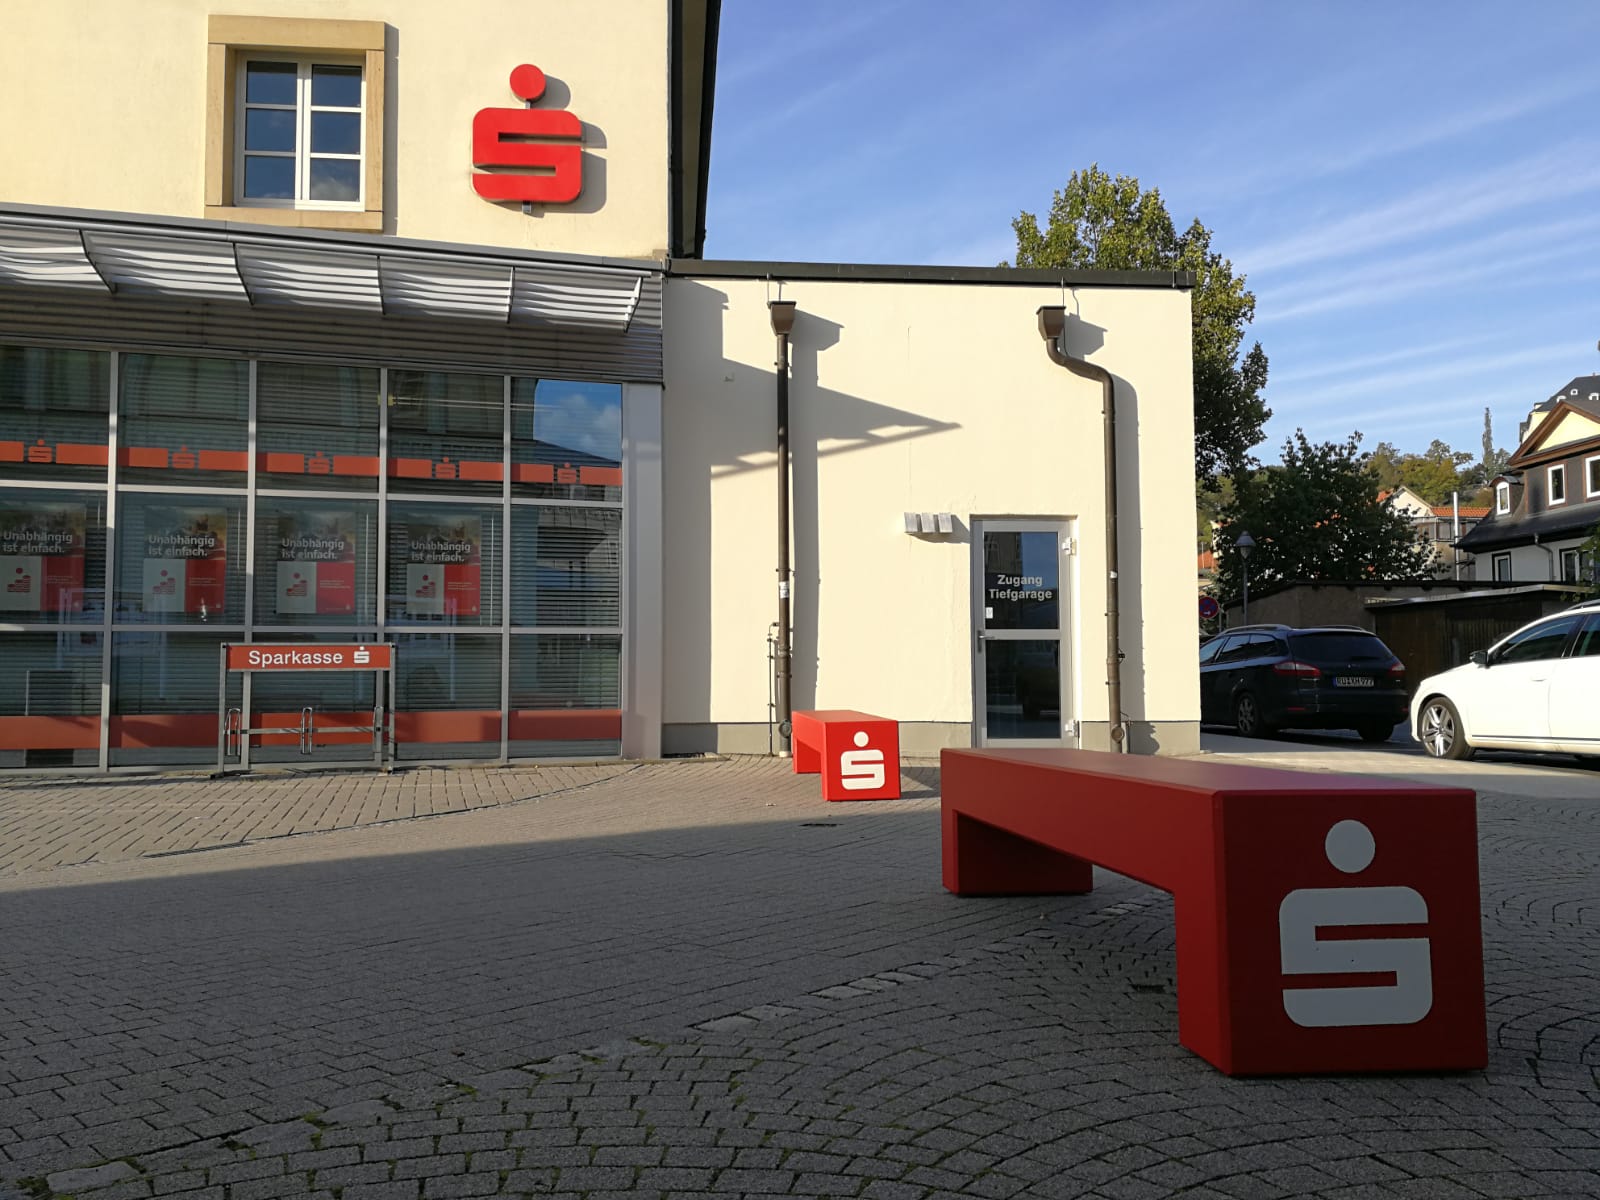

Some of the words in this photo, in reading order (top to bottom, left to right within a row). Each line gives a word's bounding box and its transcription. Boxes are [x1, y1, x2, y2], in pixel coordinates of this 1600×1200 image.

[3, 531, 73, 544] Unabhängig
[149, 535, 215, 547] Unabhängig
[3, 544, 18, 553] ist
[20, 543, 65, 553] einfach.
[282, 538, 344, 550] Unabhängig
[411, 541, 471, 553] Unabhängig
[149, 546, 162, 555] ist
[164, 546, 208, 557] einfach.
[281, 549, 295, 558] ist
[297, 549, 338, 560] einfach.
[411, 552, 425, 561] ist
[426, 552, 465, 562] einfach.
[997, 574, 1043, 587] Zugang
[988, 588, 1053, 601] Tiefgarage
[248, 650, 343, 668] Sparkasse
